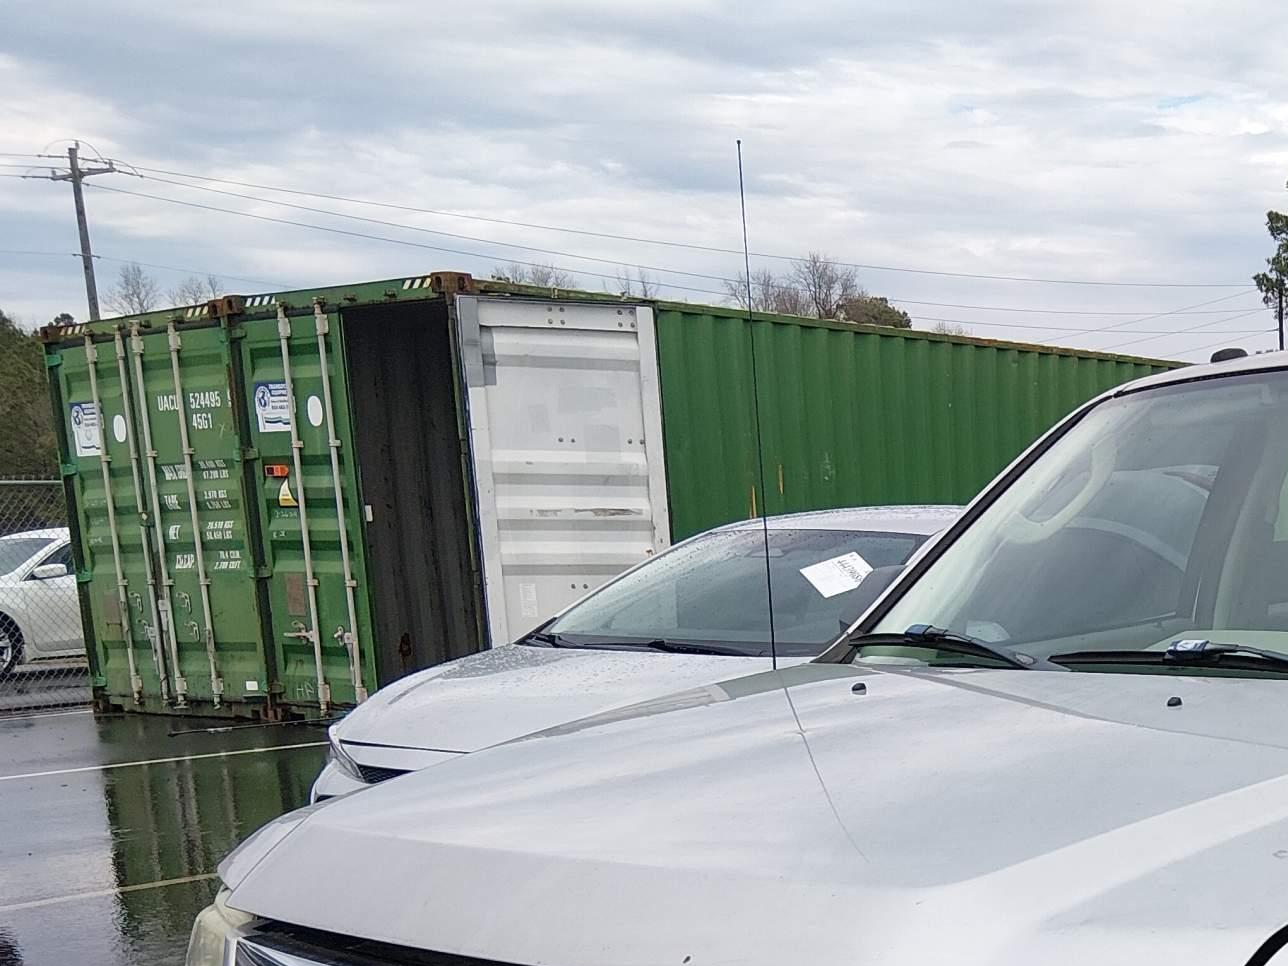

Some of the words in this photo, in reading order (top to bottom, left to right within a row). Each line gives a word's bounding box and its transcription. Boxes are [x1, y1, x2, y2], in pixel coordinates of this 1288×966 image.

[157, 395, 179, 411] UACU
[189, 391, 221, 409] 524495
[192, 413, 213, 430] 45G1
